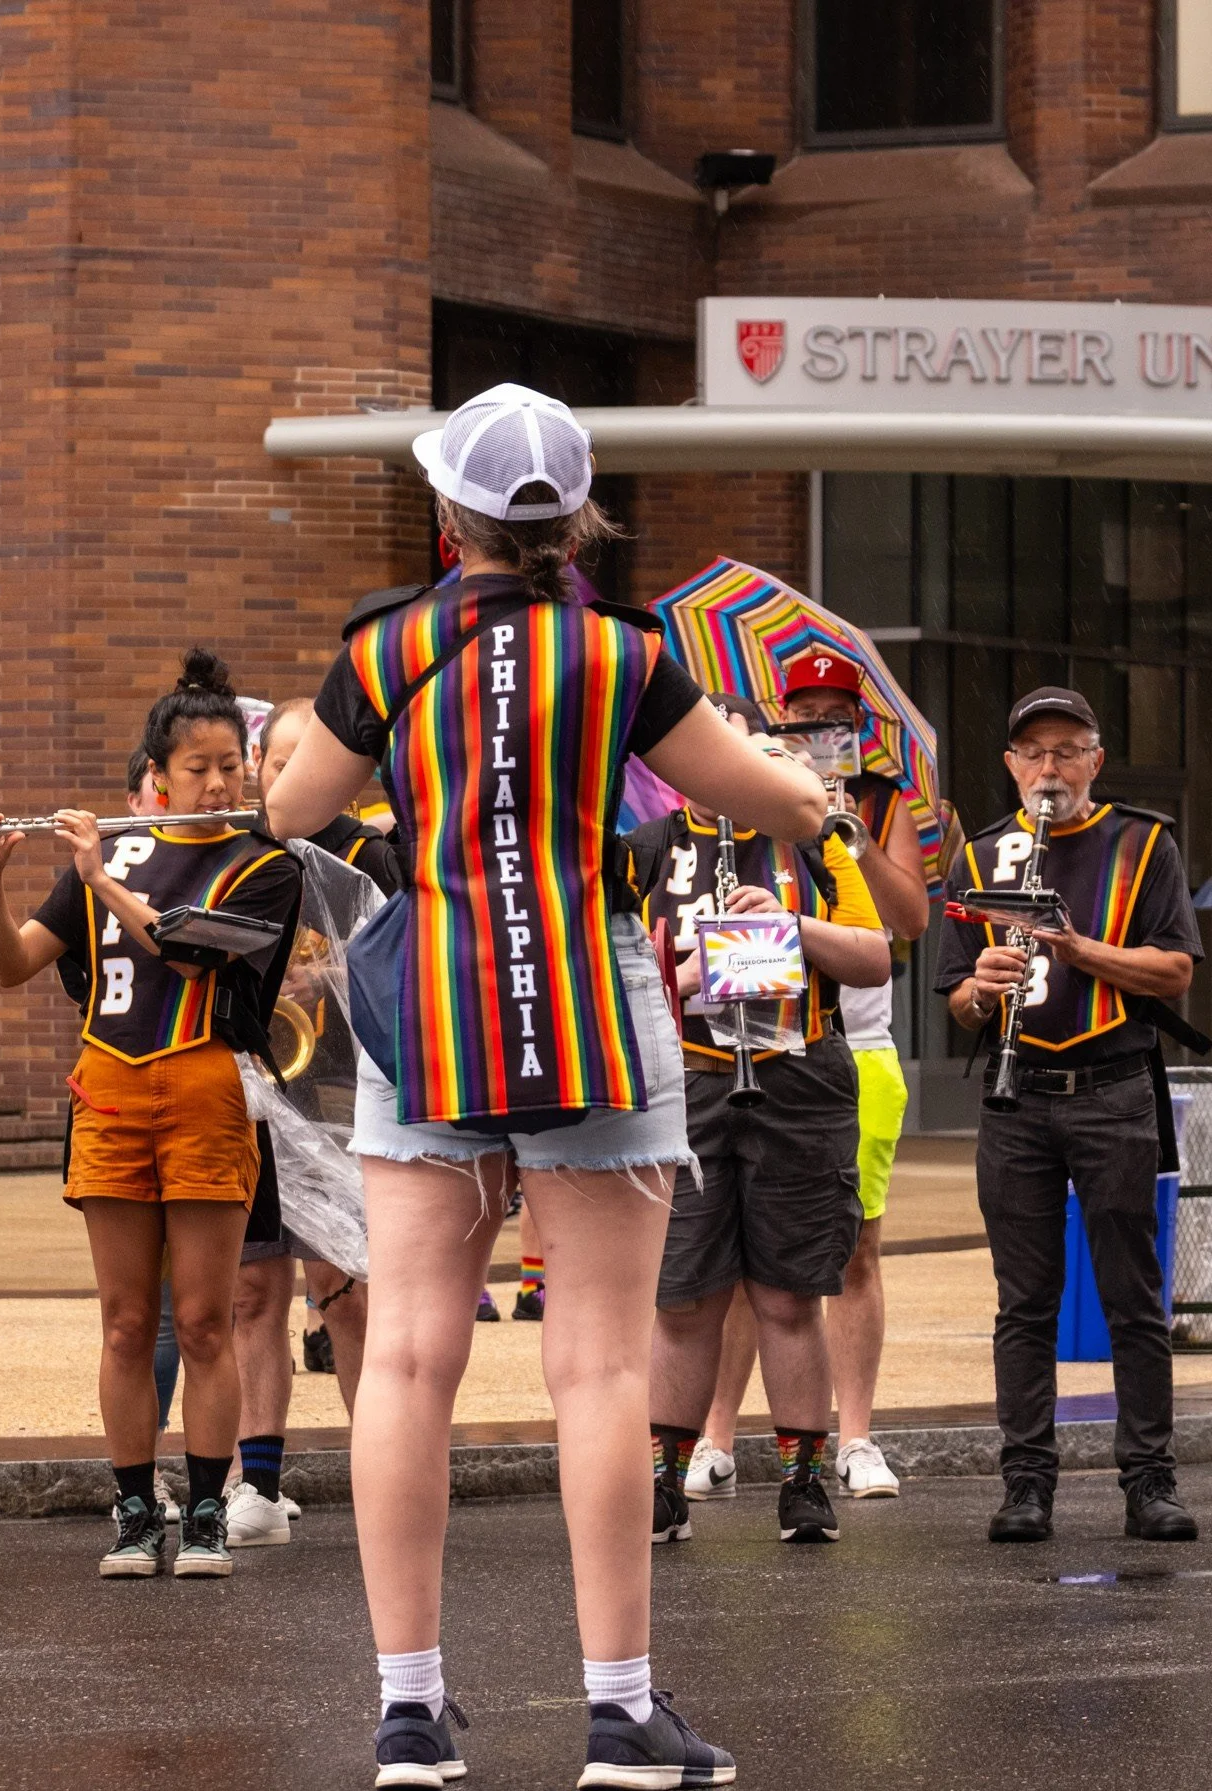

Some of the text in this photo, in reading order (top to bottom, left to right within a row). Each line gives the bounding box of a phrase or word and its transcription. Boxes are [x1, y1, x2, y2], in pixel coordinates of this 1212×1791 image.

[802, 325, 1115, 385] STRAYER
[813, 657, 833, 678] P
[491, 625, 543, 1078] PHILADELPHIA
